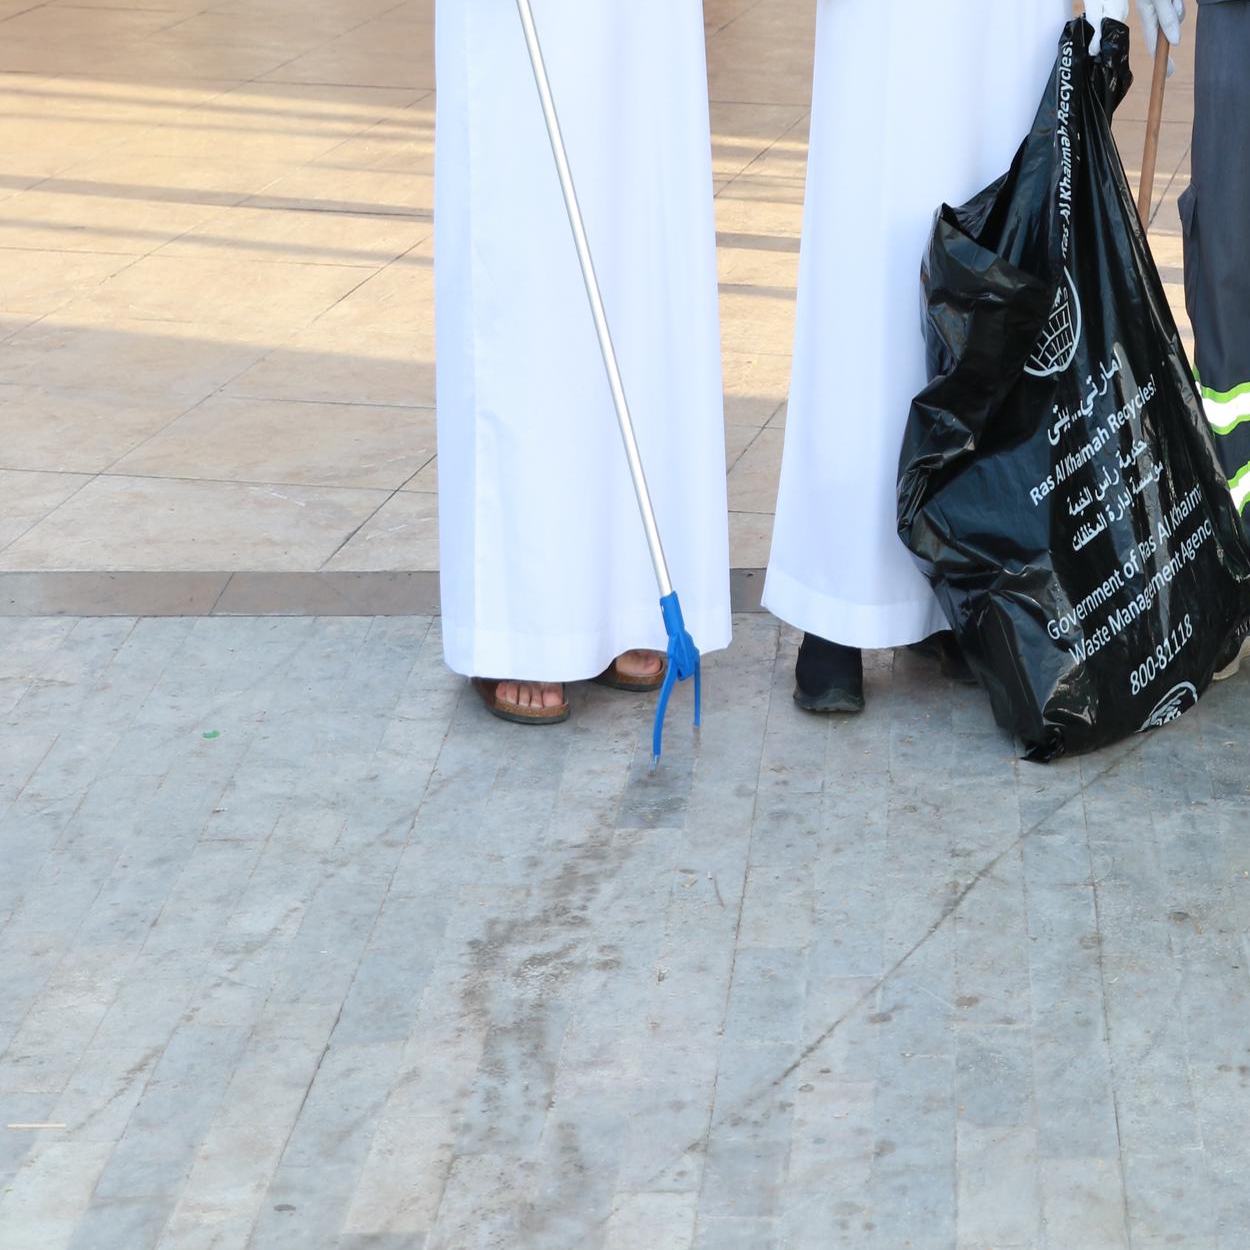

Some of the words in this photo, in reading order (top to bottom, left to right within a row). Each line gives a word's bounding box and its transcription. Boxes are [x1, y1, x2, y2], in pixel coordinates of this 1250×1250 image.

[1057, 128, 1071, 202] Khaimah
[1029, 475, 1055, 506] Ras
[1055, 464, 1066, 485] Al
[1064, 427, 1110, 479] Khaimah
[1107, 374, 1157, 434] Recycles!
[1118, 439, 1147, 469] حكومة
[1095, 466, 1119, 500] رأس
[1047, 568, 1124, 640] Government
[1123, 549, 1141, 579] of
[1138, 537, 1157, 564] Ras
[1157, 521, 1171, 544] Al
[1170, 483, 1203, 537] Khaim
[1072, 514, 1108, 551] المخلفات
[1068, 627, 1111, 665] Waste
[1108, 558, 1184, 636] Management
[1180, 517, 1214, 566] Agenc
[1130, 613, 1193, 695] 800-81118
